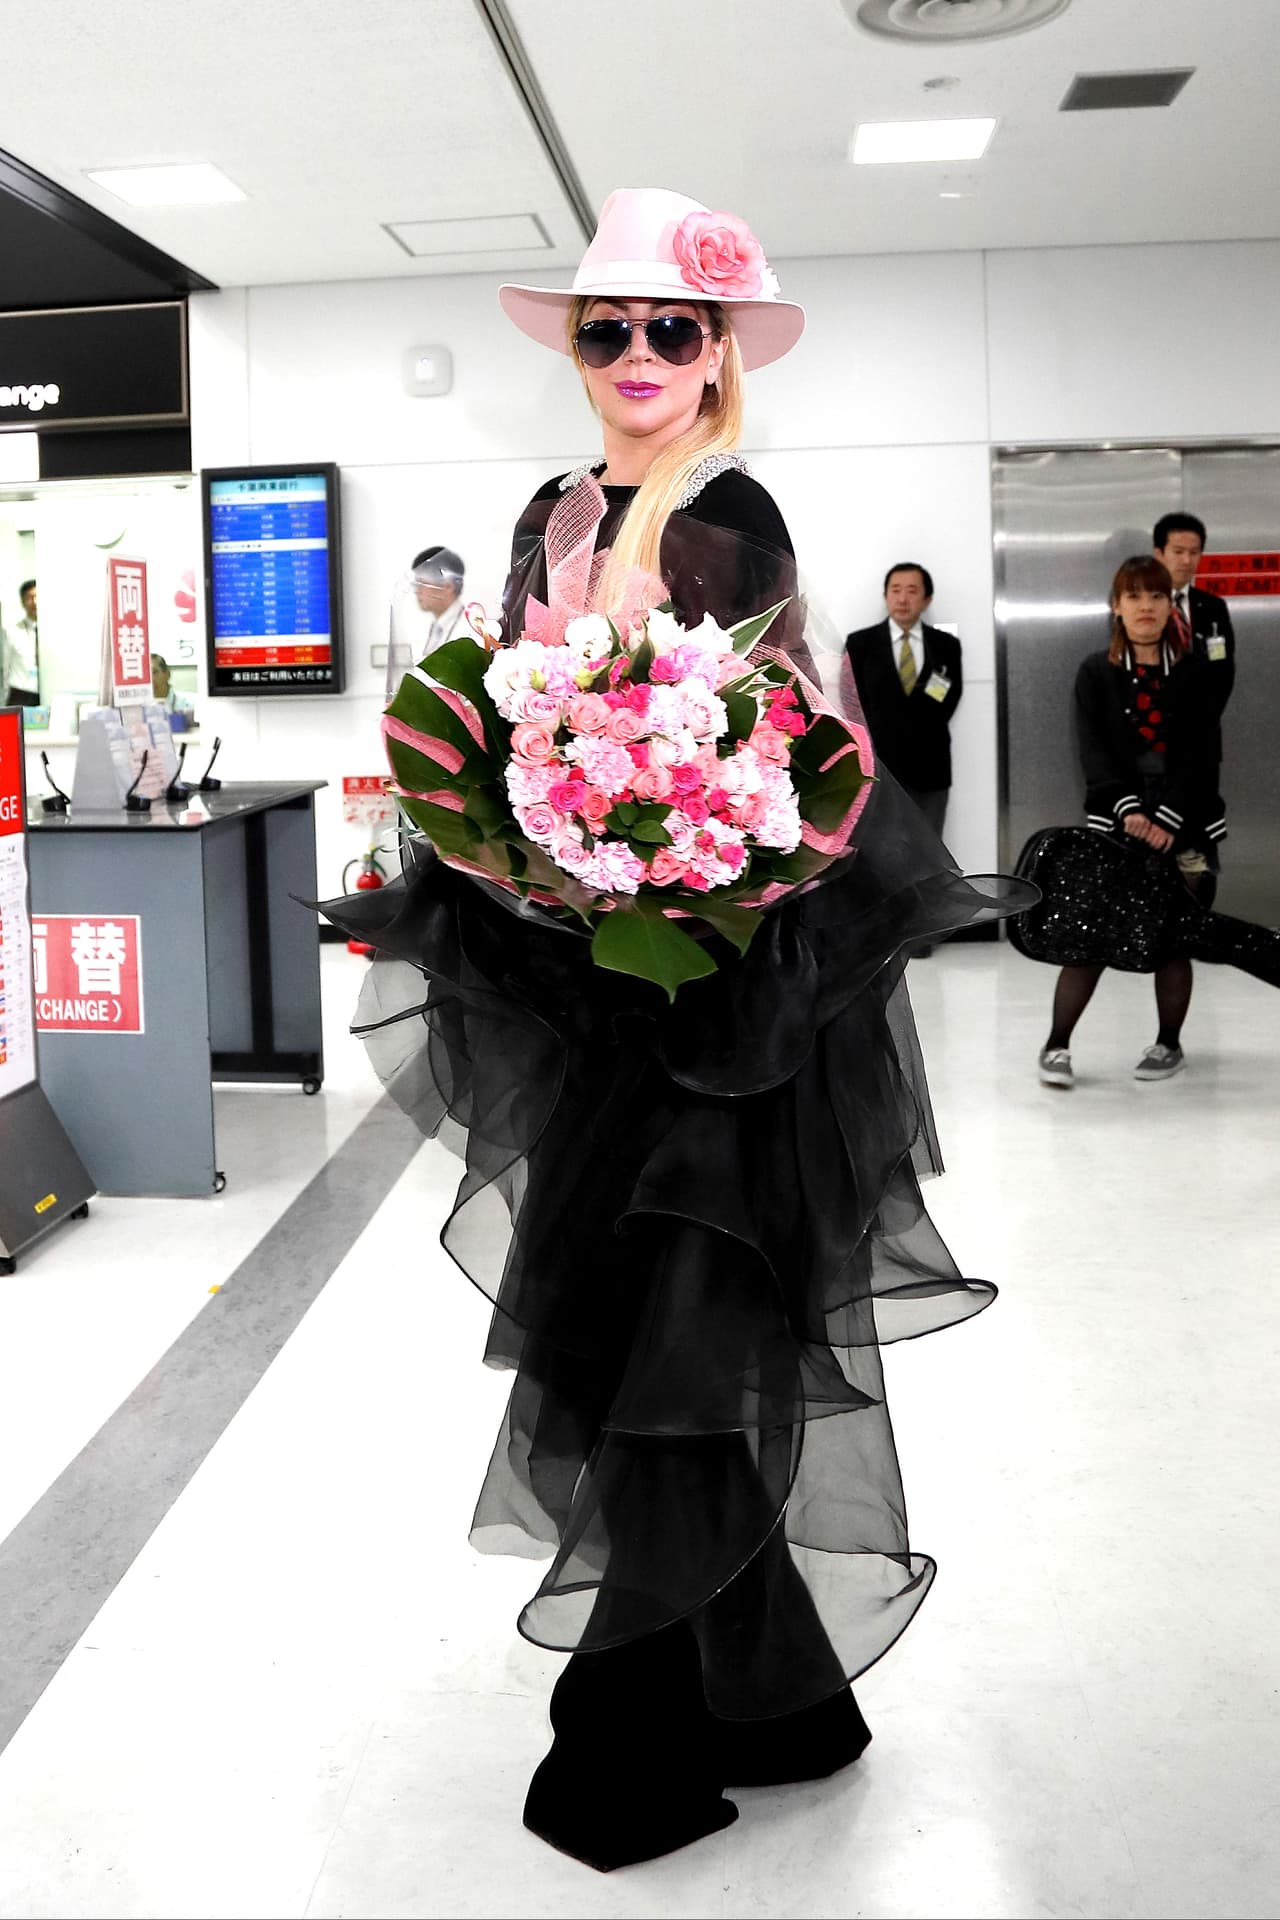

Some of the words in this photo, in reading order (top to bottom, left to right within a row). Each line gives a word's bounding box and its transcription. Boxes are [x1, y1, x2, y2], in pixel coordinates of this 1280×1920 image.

[0, 383, 60, 411] ange
[115, 565, 146, 681] 両替
[33, 922, 127, 996] 替
